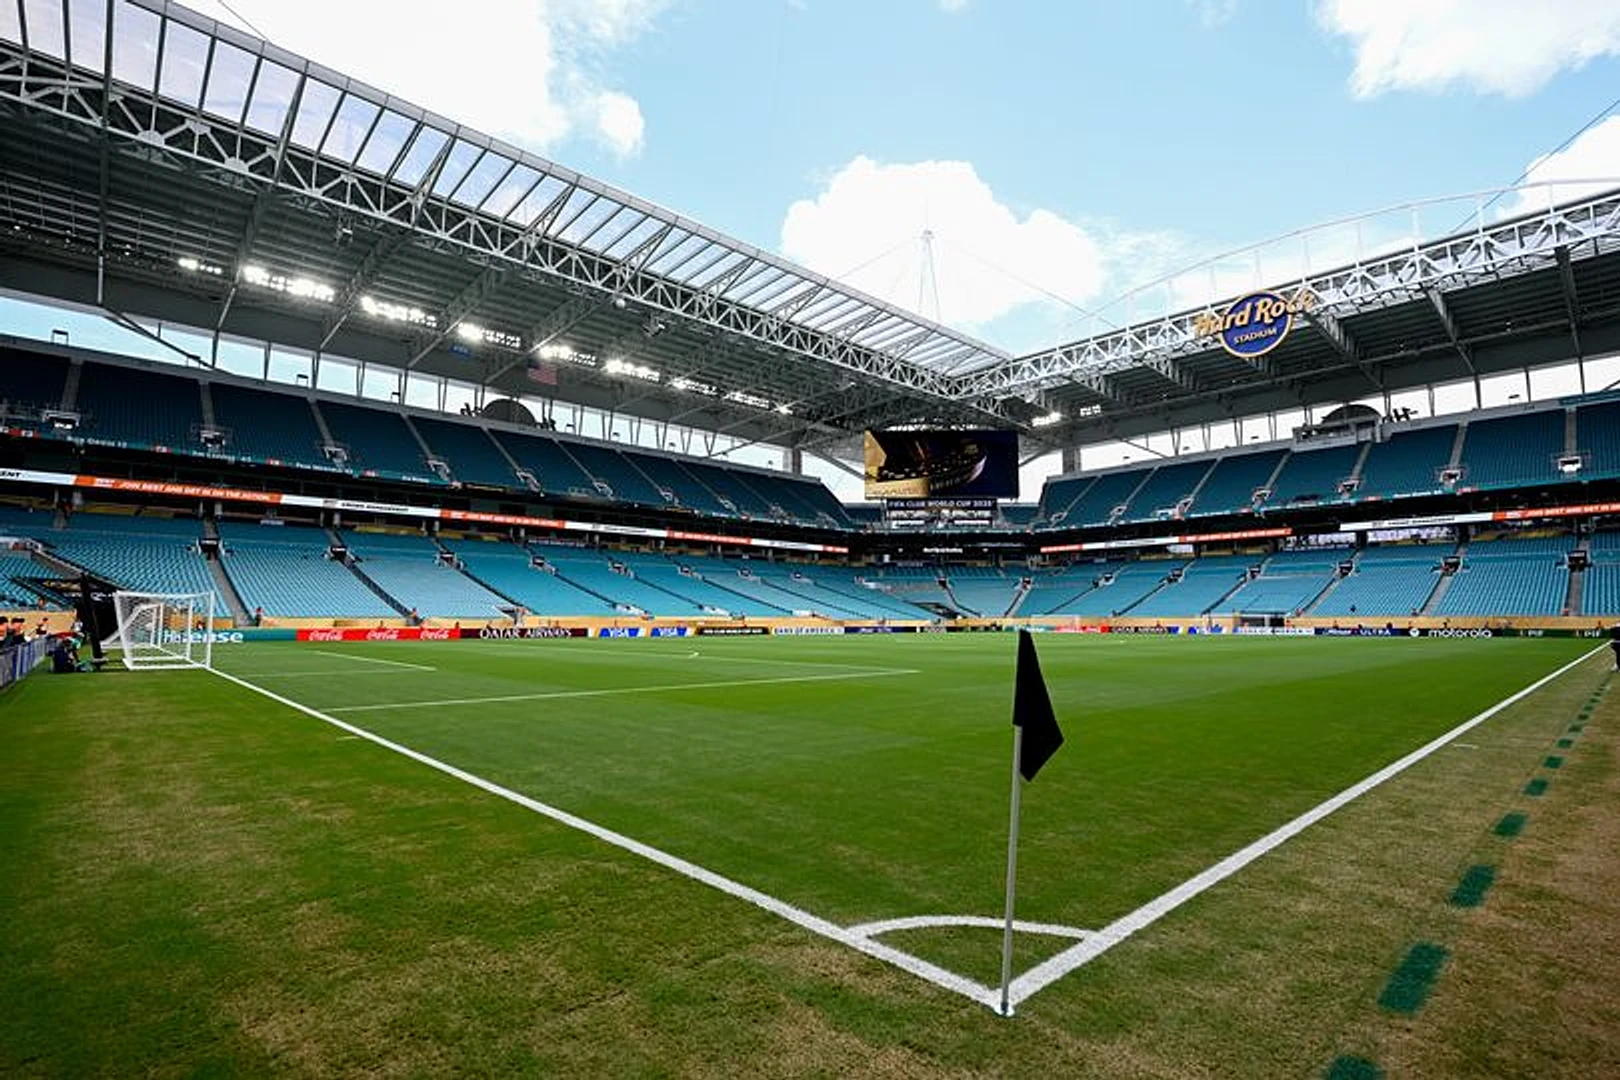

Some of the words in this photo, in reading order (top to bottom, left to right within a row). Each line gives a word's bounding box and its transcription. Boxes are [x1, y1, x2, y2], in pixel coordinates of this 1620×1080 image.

[1194, 302, 1251, 338] Hard
[1254, 288, 1316, 325] Rock
[1234, 327, 1278, 344] STADIUM
[928, 500, 955, 508] WORLD
[956, 500, 971, 508] CUP
[480, 628, 520, 639] QATAR
[524, 628, 572, 638] AIRWAYS
[1428, 627, 1493, 638] motorola
